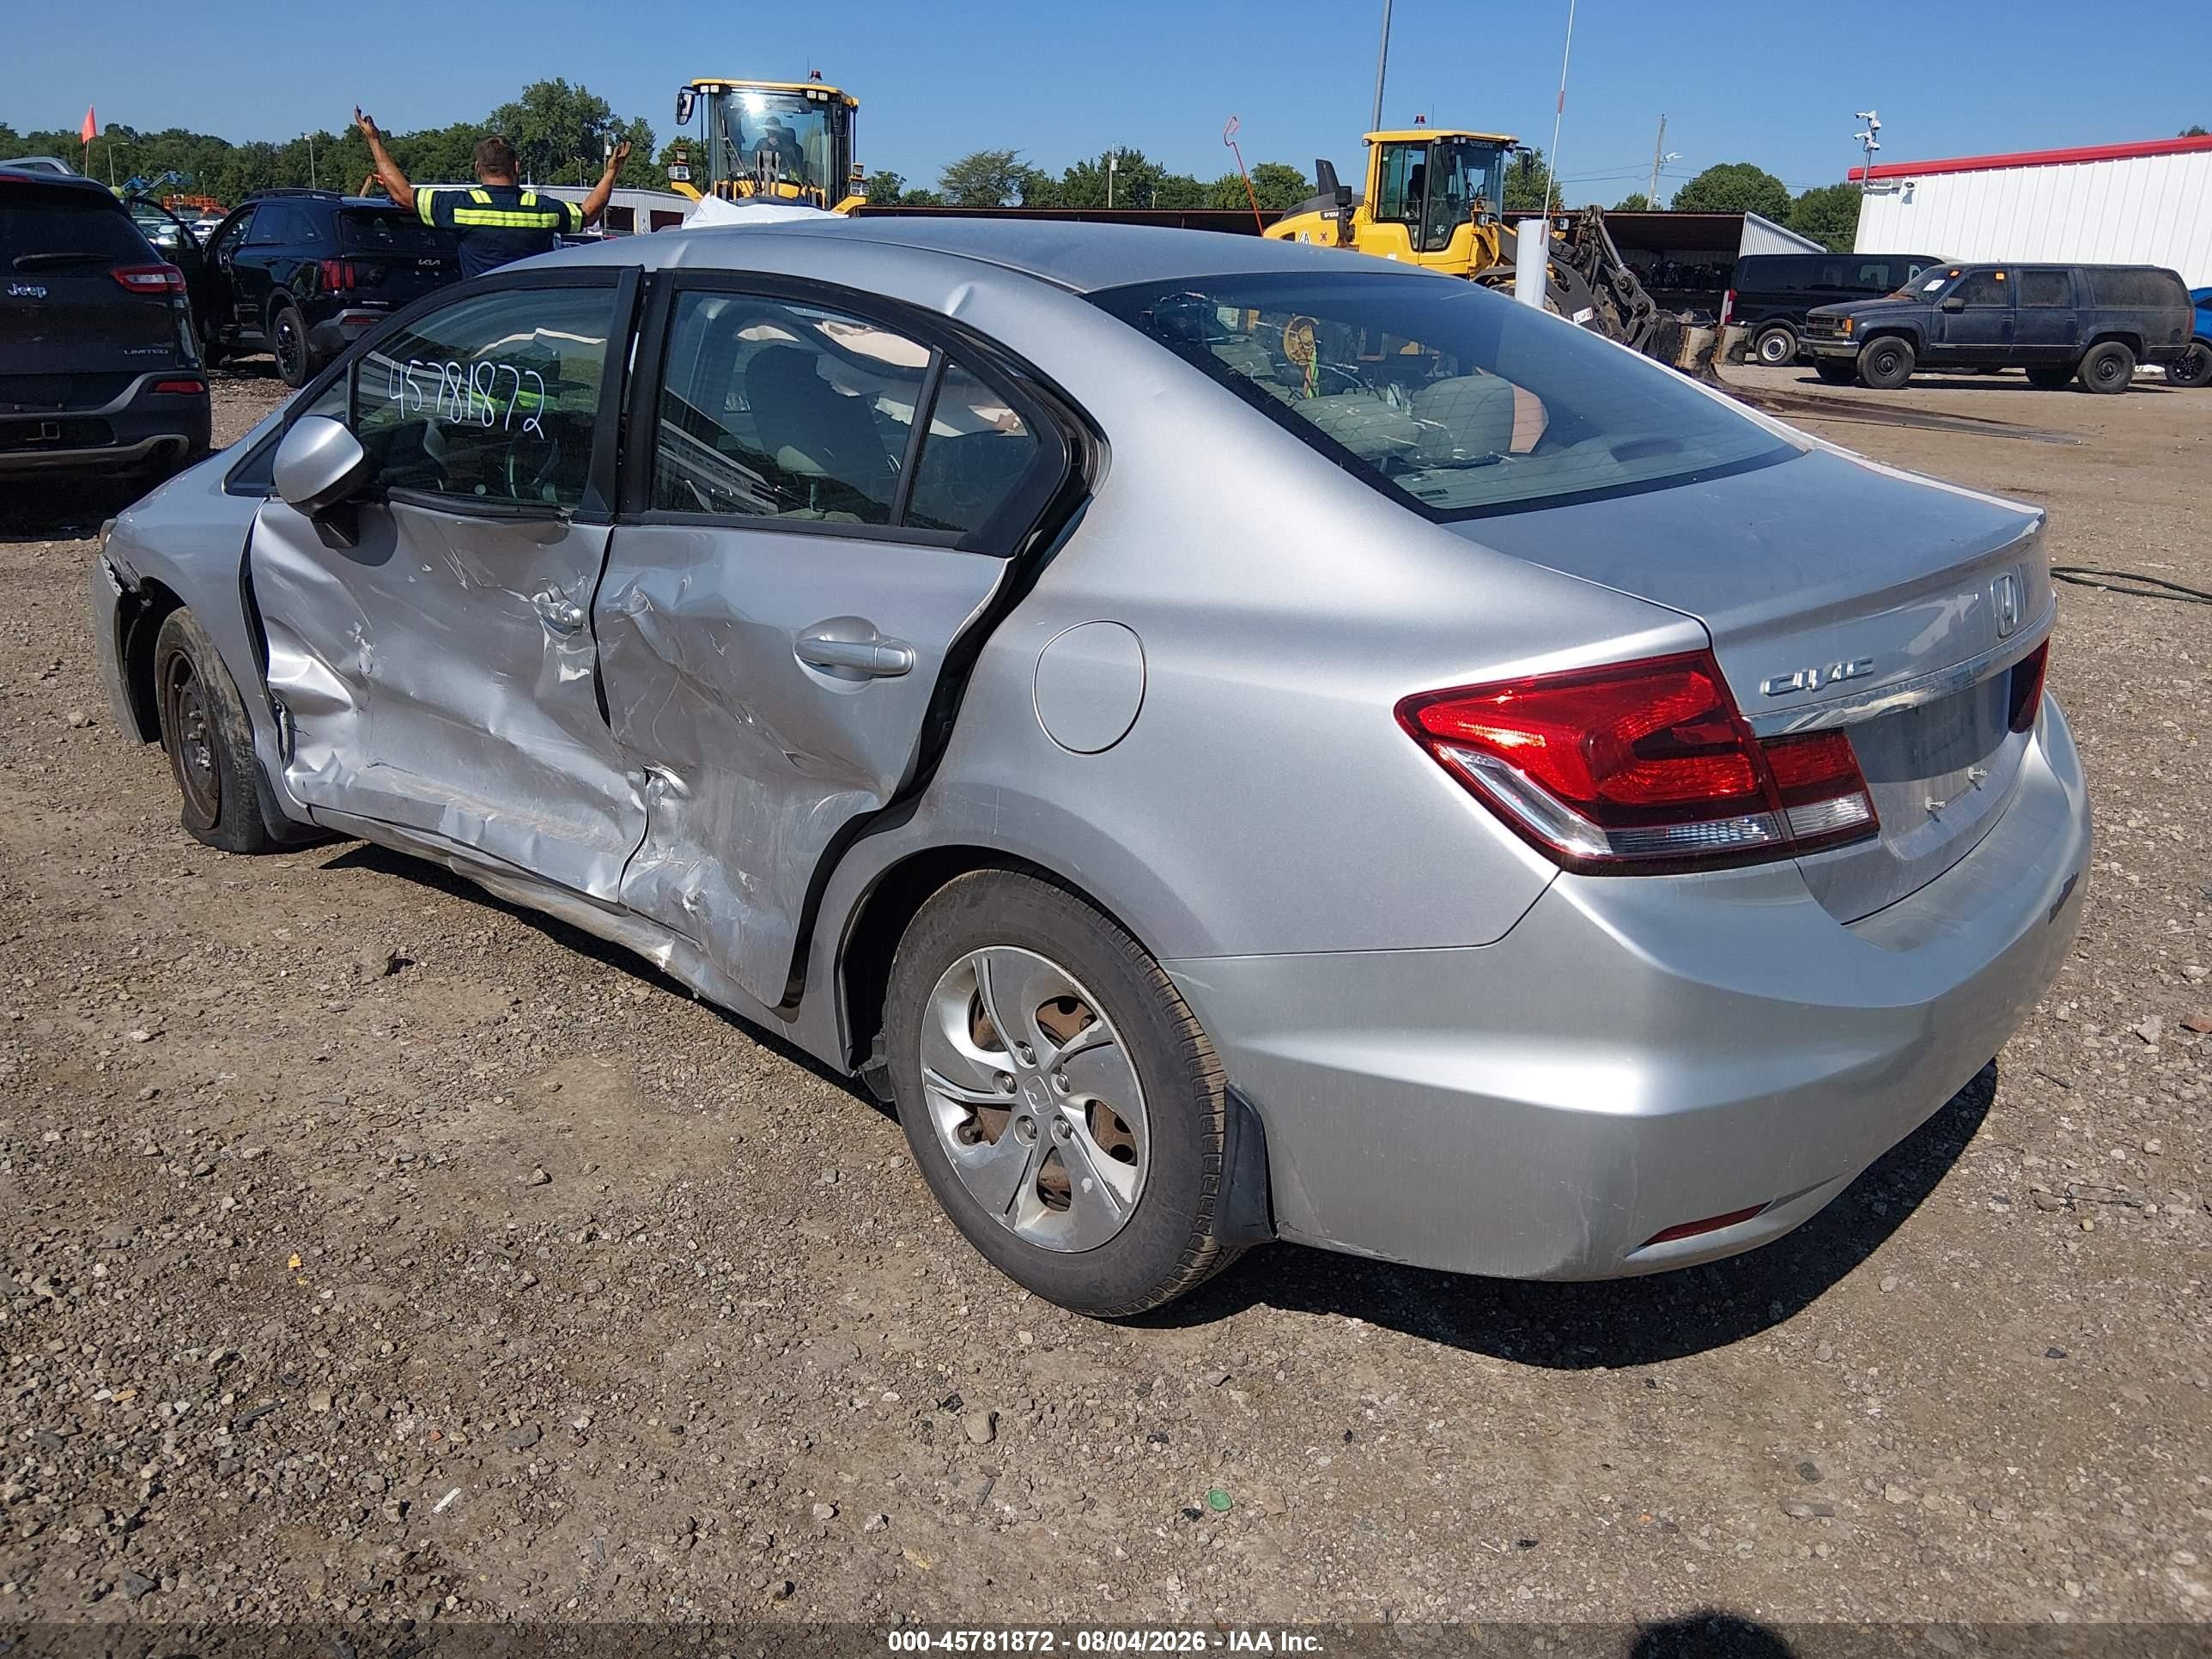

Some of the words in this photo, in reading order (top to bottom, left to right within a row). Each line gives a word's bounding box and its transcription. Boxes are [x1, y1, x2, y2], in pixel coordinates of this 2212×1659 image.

[7, 283, 48, 299] Jeep
[388, 359, 544, 441] 45781872
[1759, 656, 1875, 696] CIVIC
